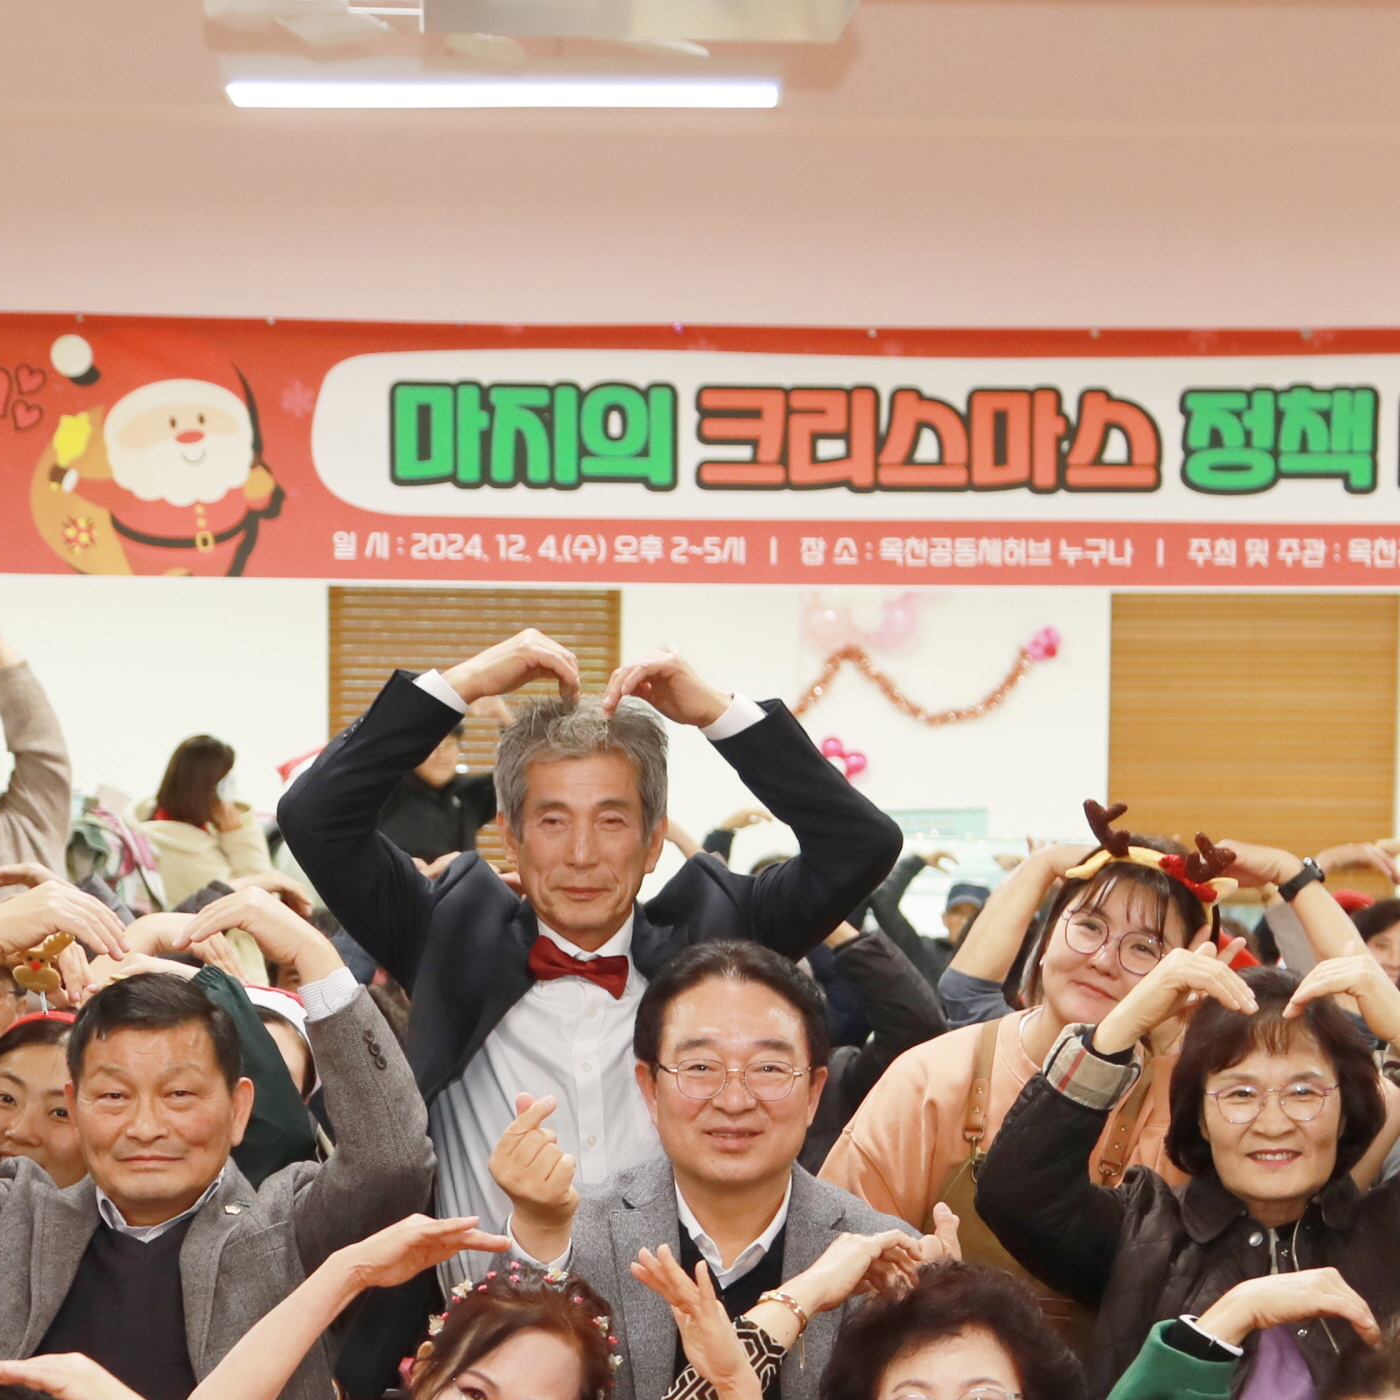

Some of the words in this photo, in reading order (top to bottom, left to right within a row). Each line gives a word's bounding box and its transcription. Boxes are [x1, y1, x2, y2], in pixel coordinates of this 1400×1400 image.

[390, 382, 678, 490] 마지의
[696, 385, 1162, 493] 크리스마스
[1181, 385, 1378, 495] 정책
[332, 530, 358, 562] 일
[364, 531, 390, 562] 시
[410, 532, 490, 563] 2024.
[495, 533, 532, 563] 12.
[537, 533, 608, 565] 4.(수)
[613, 534, 664, 565] 오후
[670, 536, 746, 566] 2~5시
[800, 536, 827, 567] 장
[832, 537, 860, 566] 소
[879, 536, 1052, 568] 옥천공동체허브
[1058, 537, 1134, 568] 누구나
[1187, 537, 1237, 569] 주최
[1244, 538, 1270, 569] 및
[1276, 538, 1327, 569] 주관
